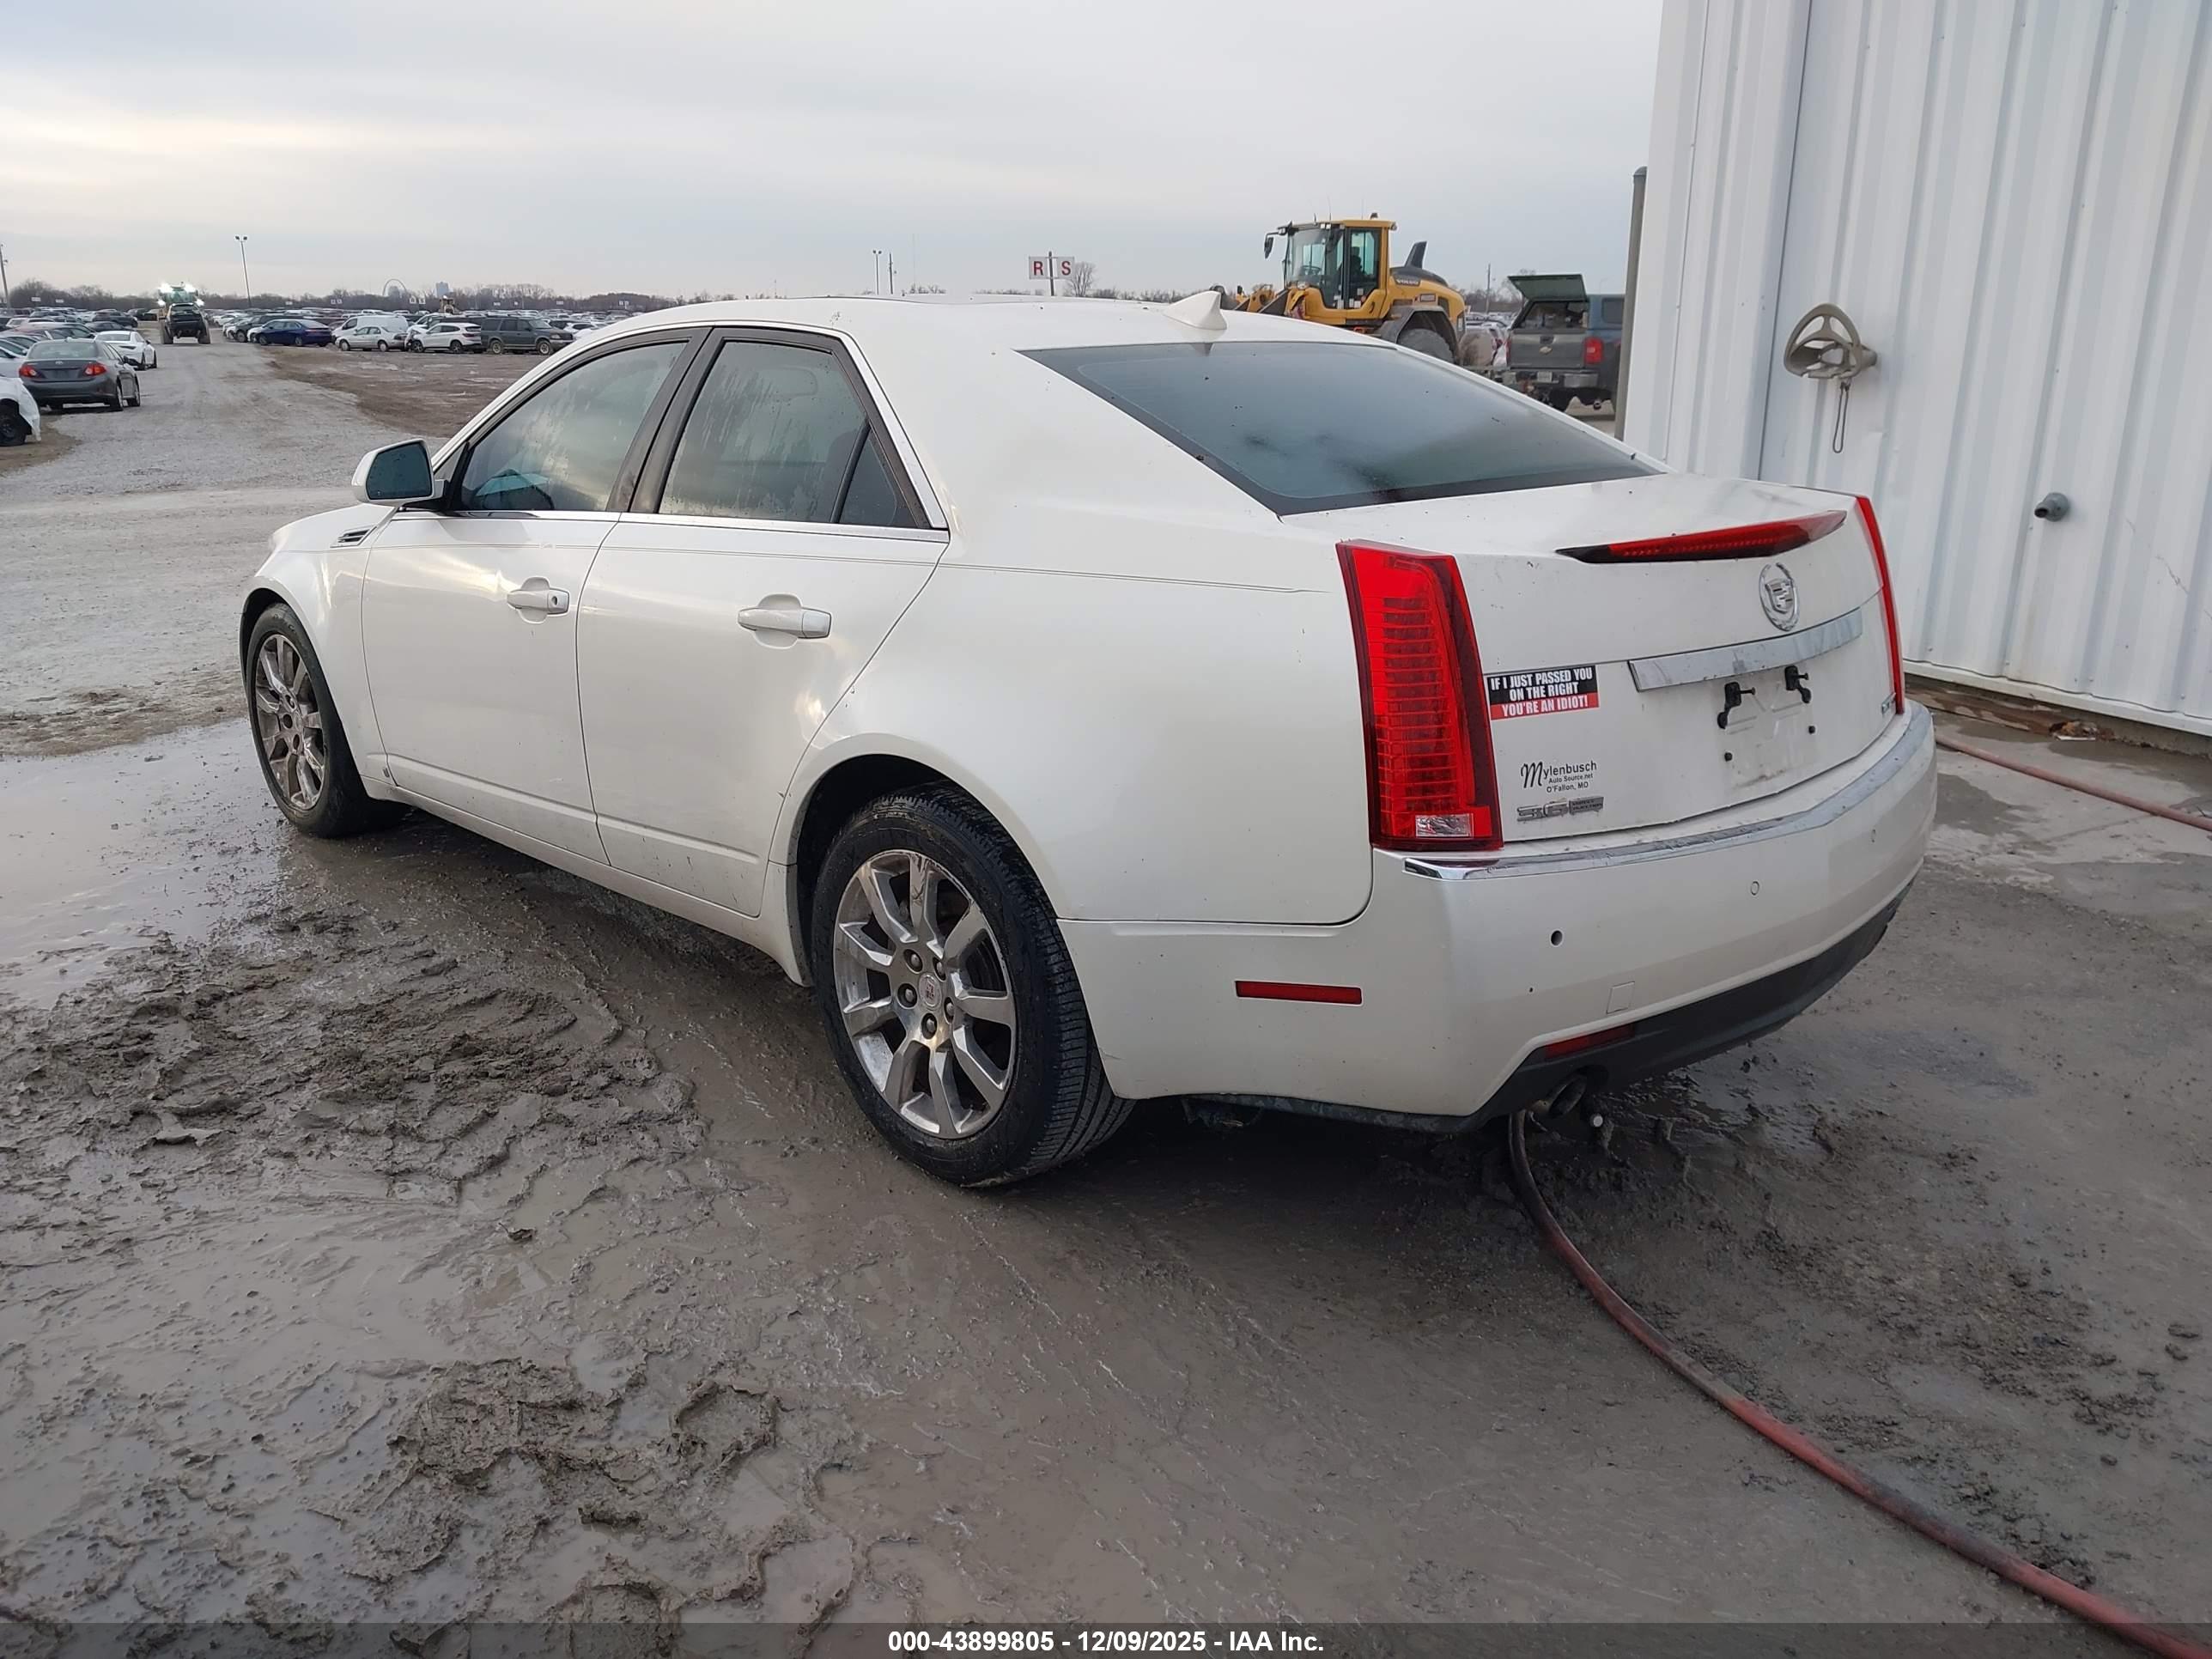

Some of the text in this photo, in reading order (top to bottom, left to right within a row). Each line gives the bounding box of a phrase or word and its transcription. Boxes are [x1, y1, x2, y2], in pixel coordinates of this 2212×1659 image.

[1033, 260, 1072, 276] R S
[1491, 666, 1593, 690] IF I JUST PASSED YOU
[1510, 682, 1579, 702] ON THE RIGHT
[1502, 694, 1589, 717] YOU'RE AN IDIOT!
[1520, 760, 1597, 788] Mylenbusch
